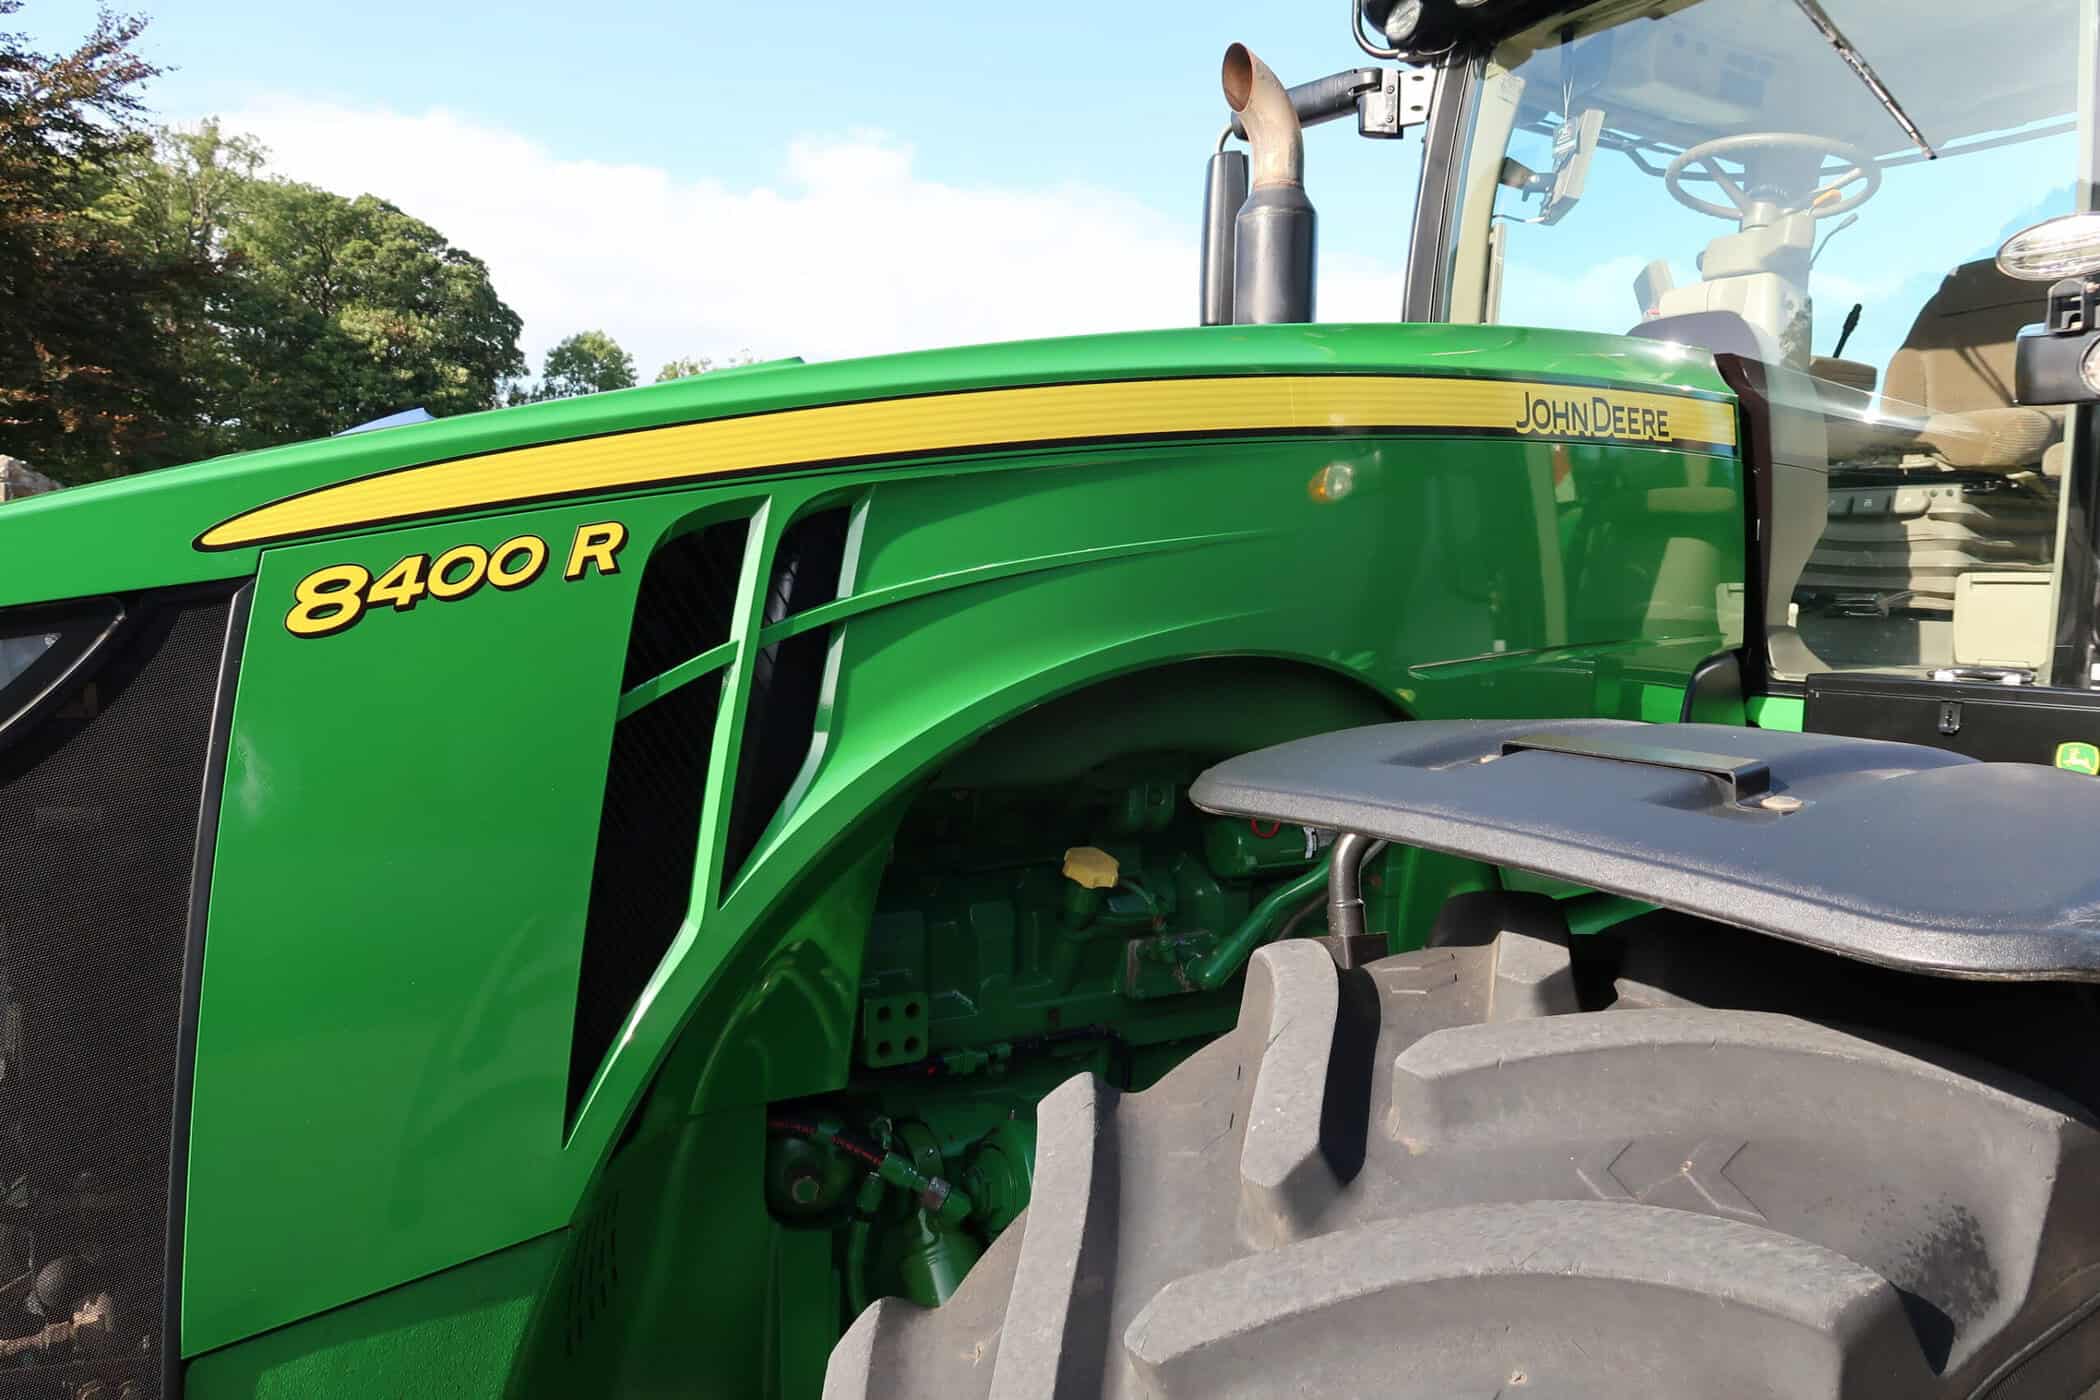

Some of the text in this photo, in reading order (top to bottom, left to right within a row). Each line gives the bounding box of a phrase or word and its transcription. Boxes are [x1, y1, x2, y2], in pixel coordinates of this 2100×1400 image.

[1516, 391, 1670, 438] JOHN DEERE
[284, 520, 629, 638] 8400 R
